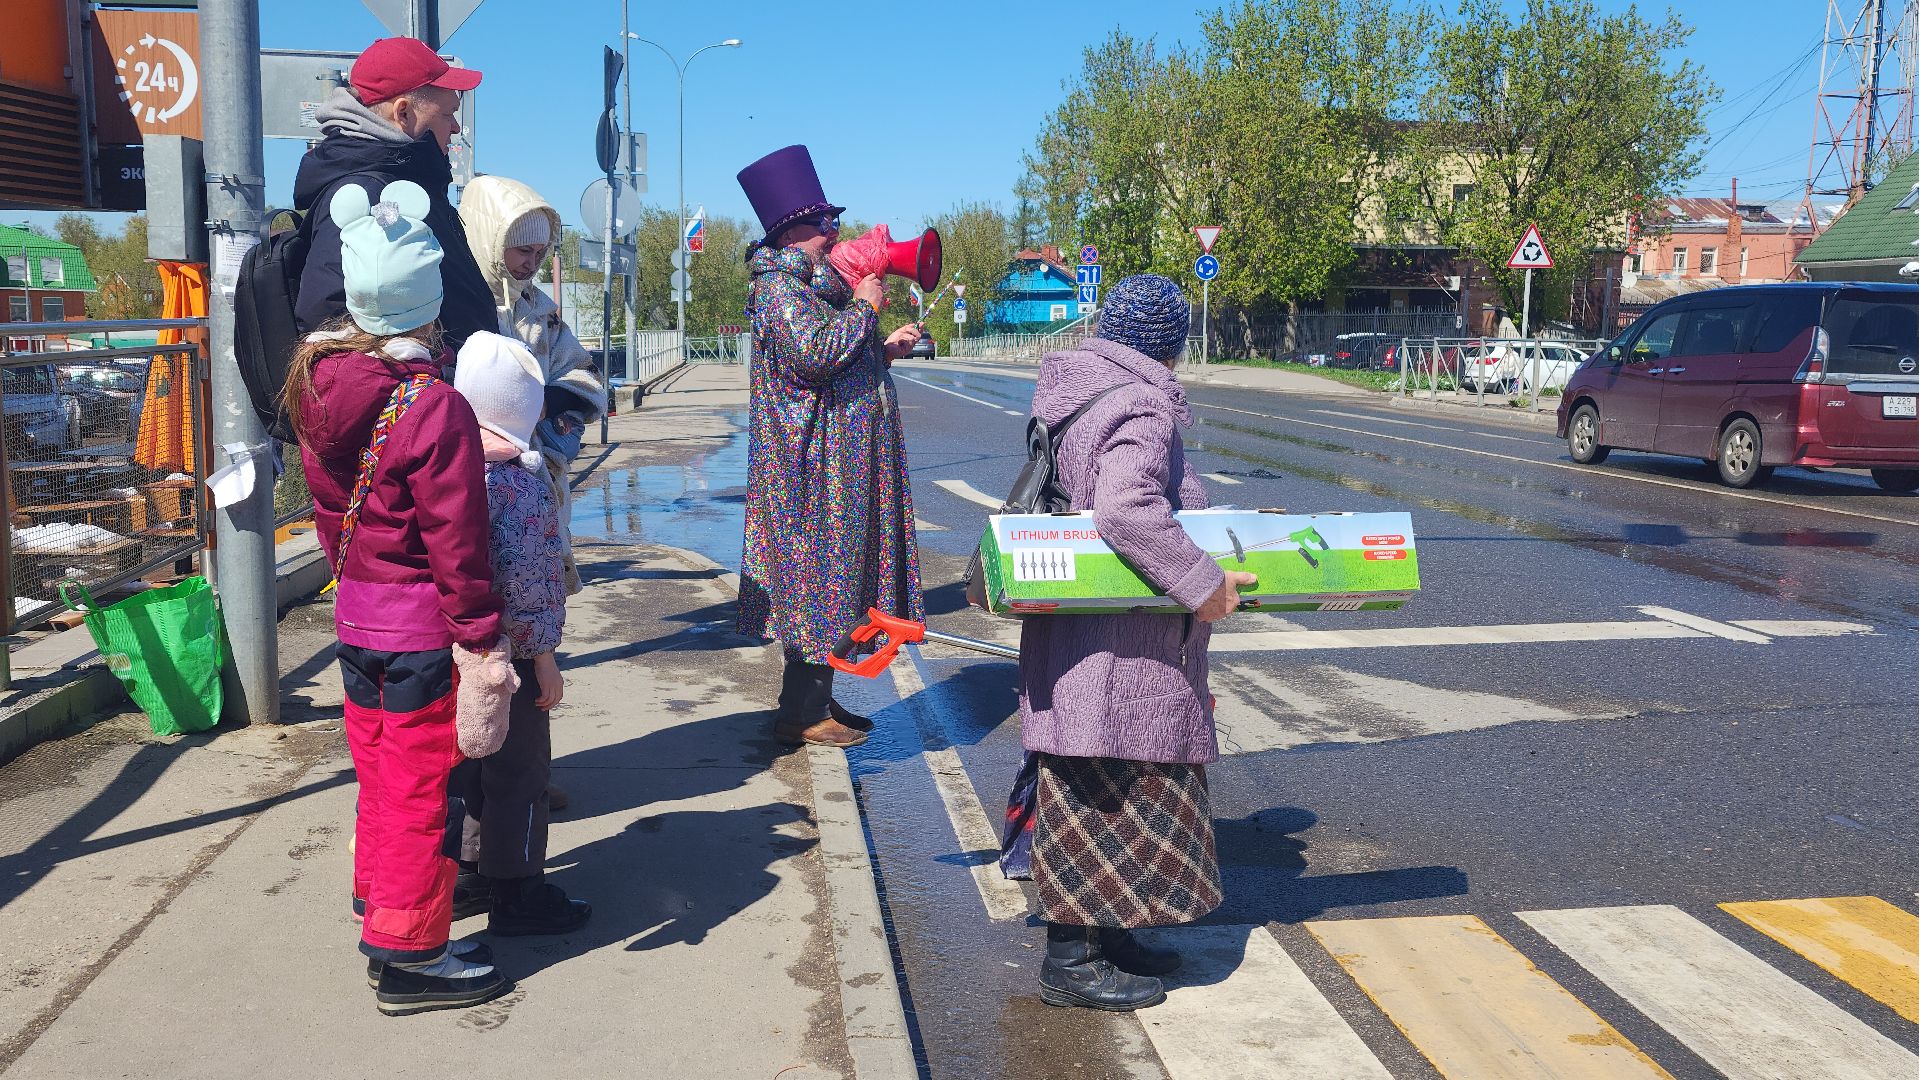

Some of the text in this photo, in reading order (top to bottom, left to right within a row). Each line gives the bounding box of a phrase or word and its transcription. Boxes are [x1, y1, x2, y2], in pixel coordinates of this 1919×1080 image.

[134, 61, 179, 92] 24ч
[1897, 397, 1912, 406] 229
[1010, 530, 1059, 541] LITHIUM
